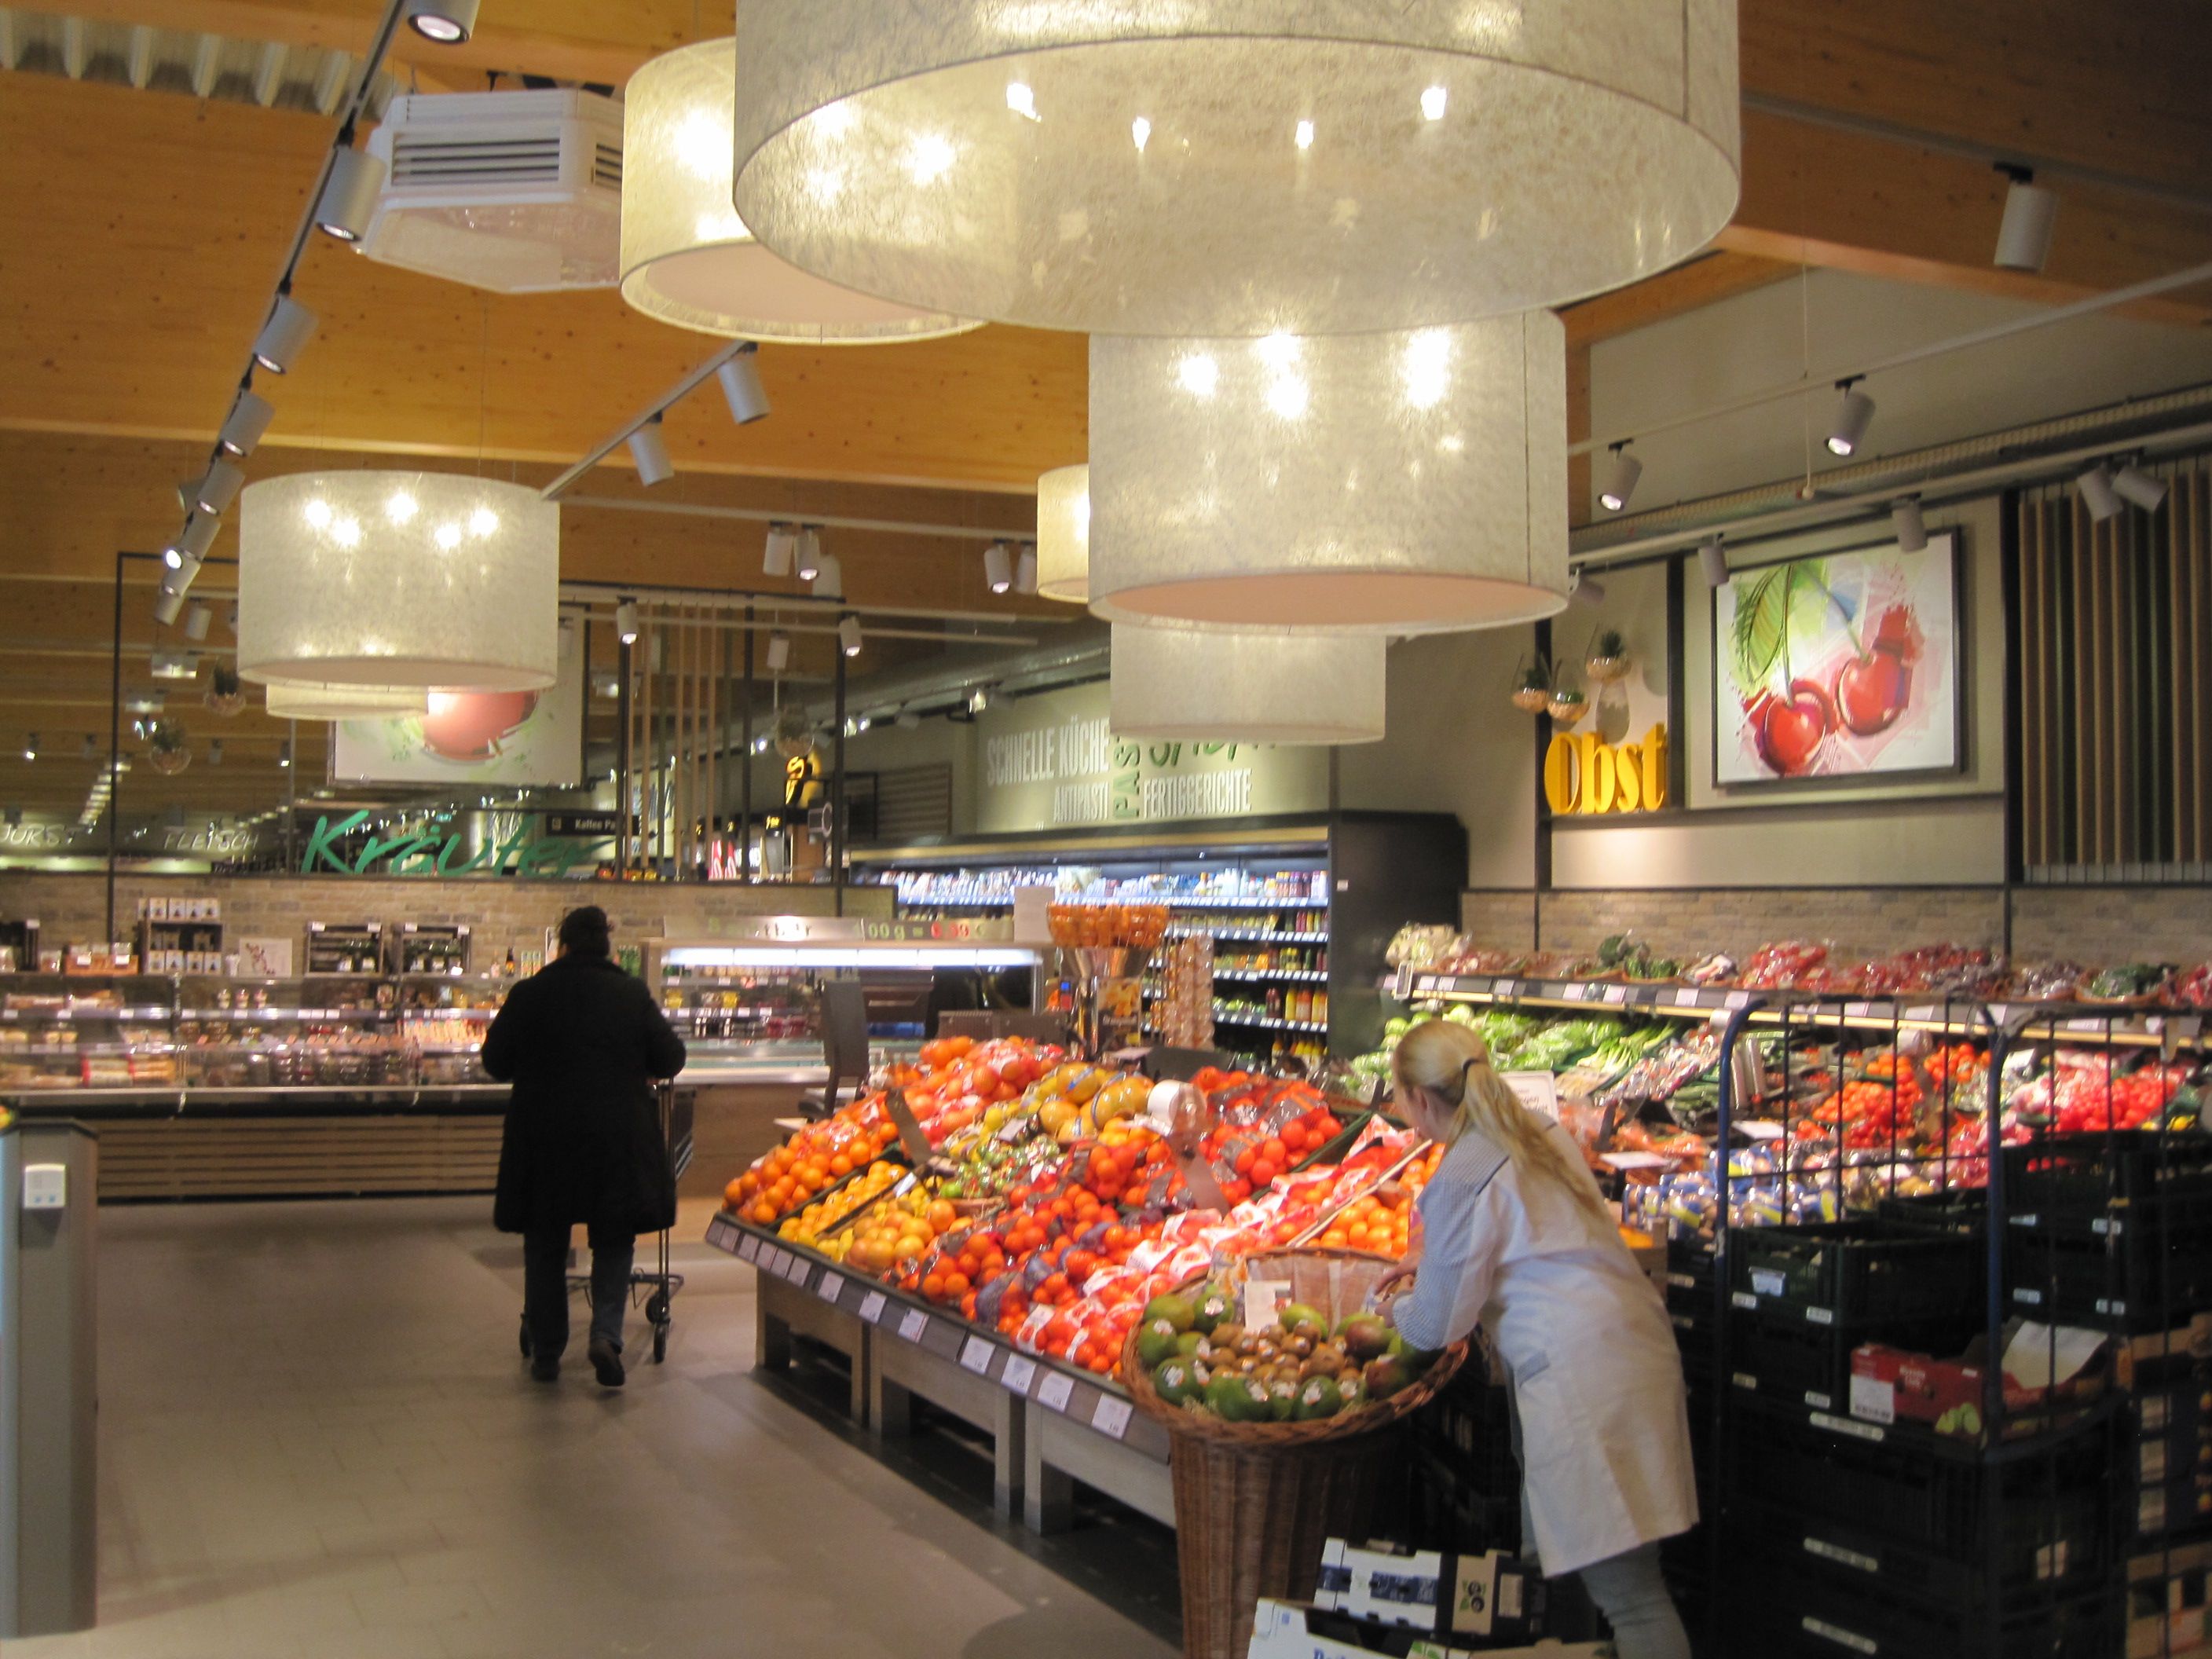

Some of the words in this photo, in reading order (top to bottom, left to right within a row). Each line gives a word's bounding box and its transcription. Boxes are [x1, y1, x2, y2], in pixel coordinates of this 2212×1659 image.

[987, 727, 1055, 786] SCHNELLE
[1059, 713, 1110, 778] KÜCHE
[1544, 722, 1666, 815] Obst
[1053, 781, 1109, 823] ANTIPASTI
[1144, 767, 1252, 819] FERTIGGERICHTE
[301, 809, 617, 877] Kräuter
